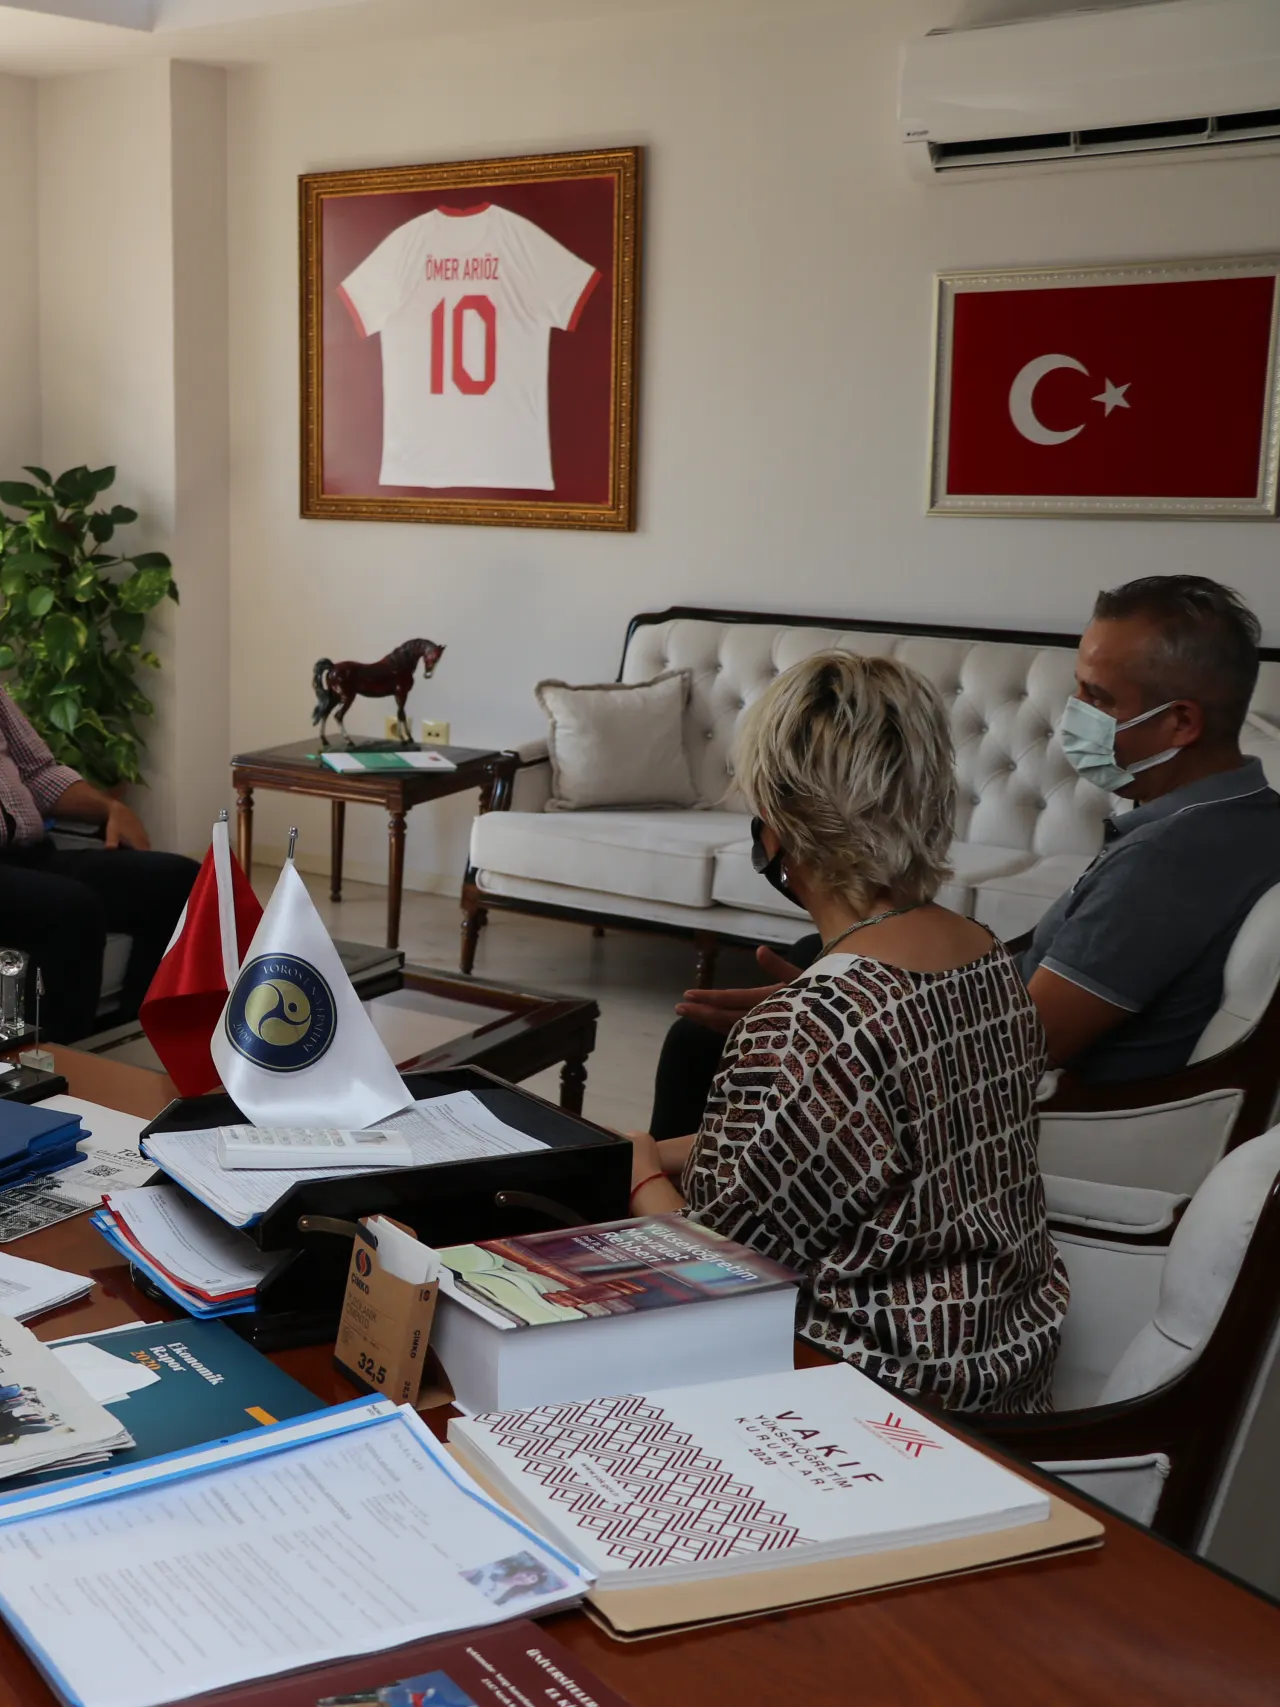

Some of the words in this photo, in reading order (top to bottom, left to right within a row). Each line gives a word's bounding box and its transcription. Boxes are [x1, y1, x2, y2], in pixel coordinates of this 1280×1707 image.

[425, 254, 459, 281] ÖMER
[463, 253, 499, 281] ARIÖZ
[430, 294, 496, 396] 10
[599, 1231, 665, 1263] Rehberi
[621, 1228, 689, 1262] Mevzuat
[644, 1223, 759, 1281] Yükseköğretim
[130, 1350, 161, 1370] 2020
[148, 1345, 186, 1373] Rapor
[166, 1342, 226, 1386] Ekonomik
[358, 1352, 387, 1384] 32,5
[735, 1417, 835, 1492] KURUMLARI
[748, 1448, 777, 1466] 2020
[755, 1414, 854, 1489] YÜKSEKÖĞRETİM
[776, 1410, 884, 1482] VAKIF
